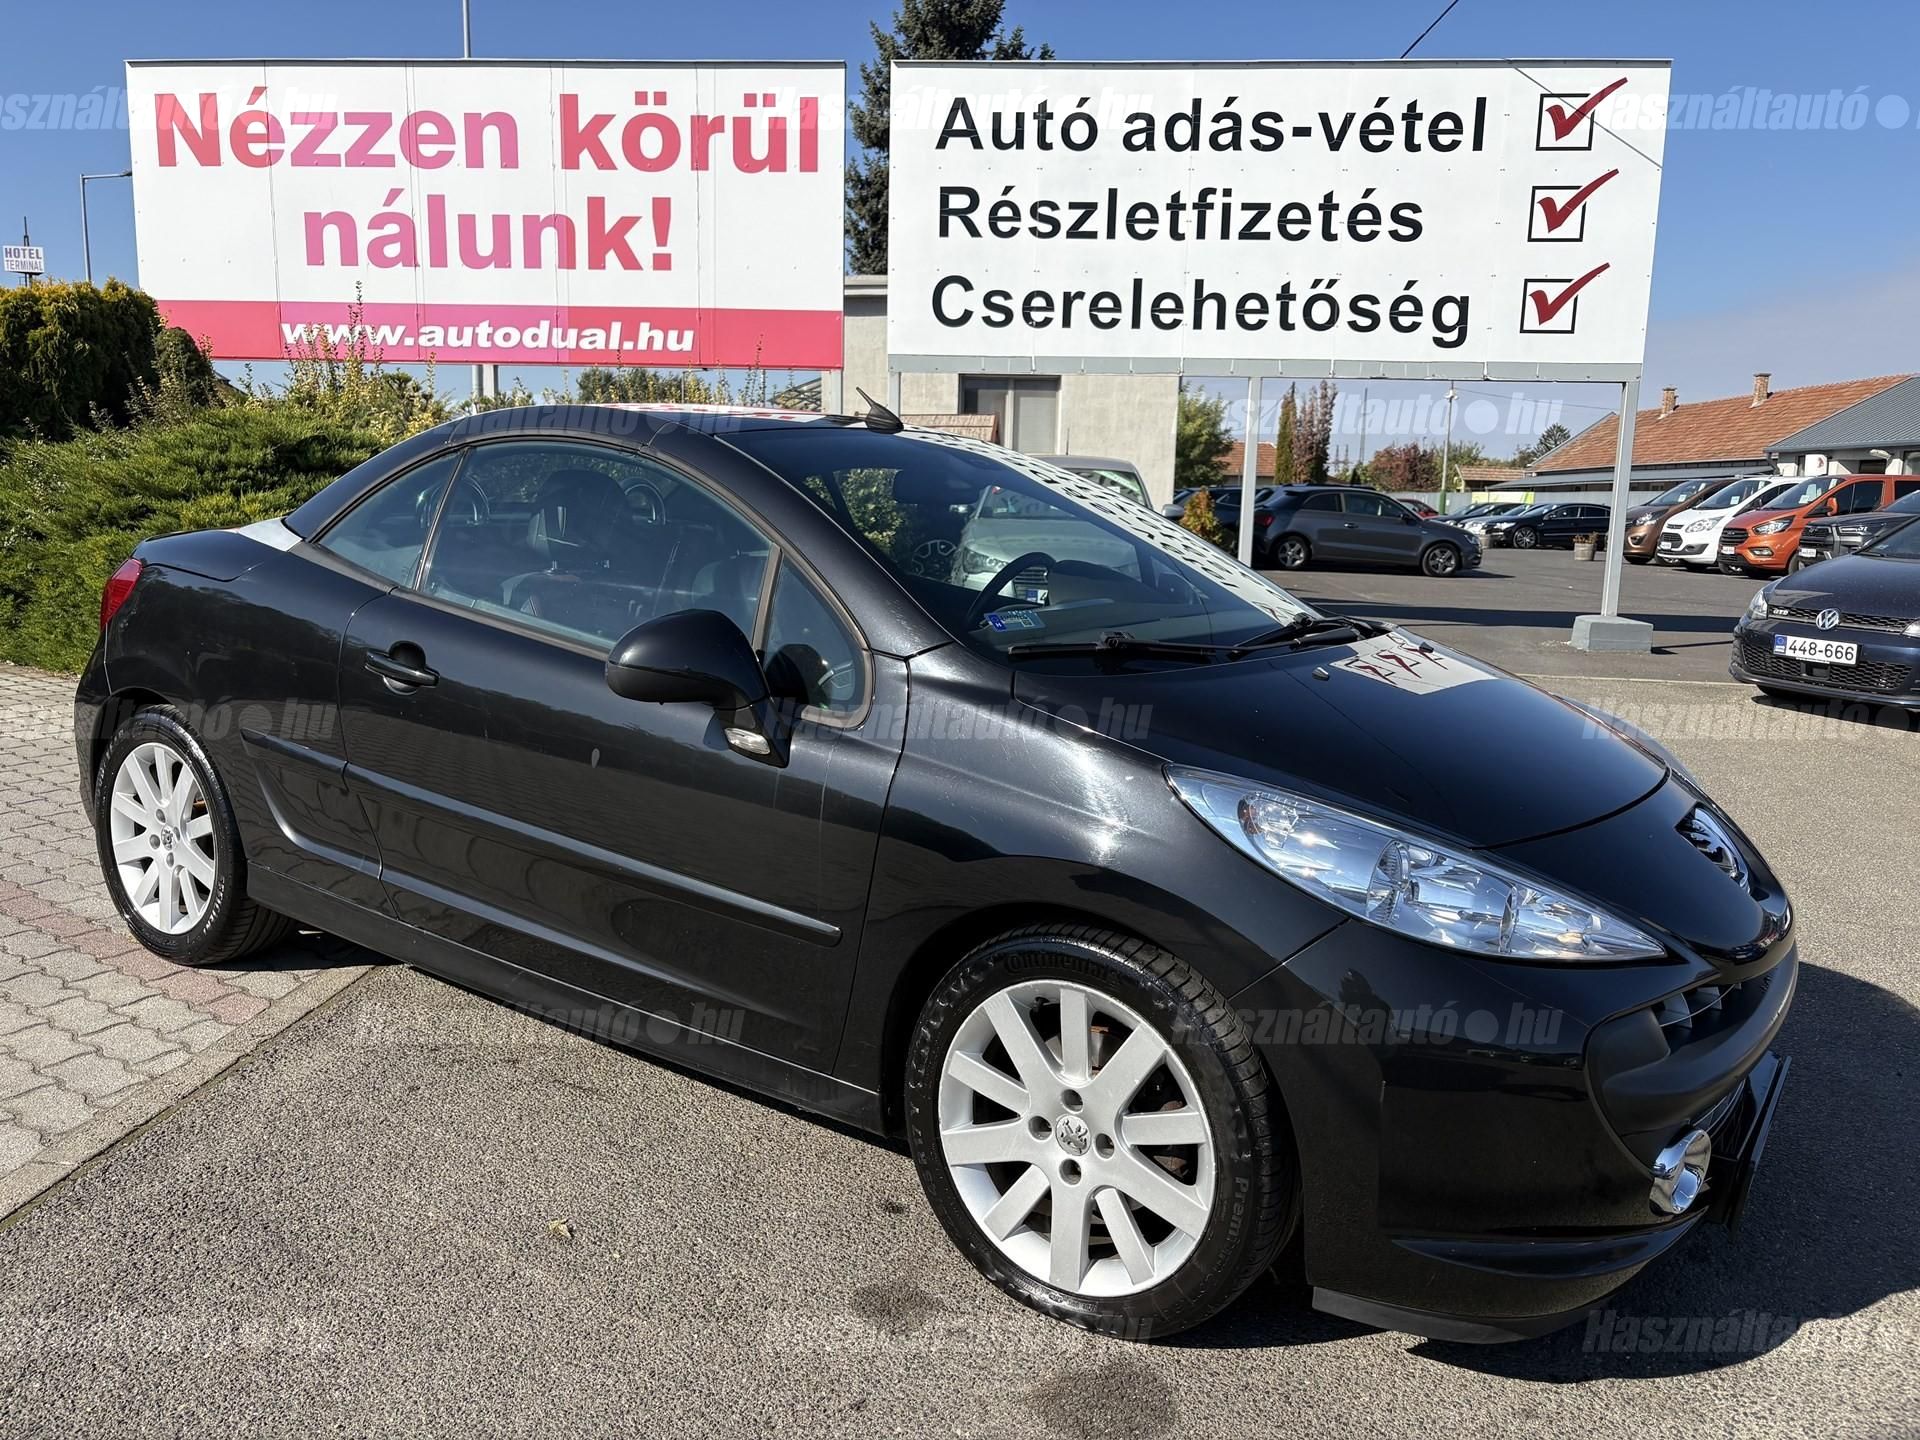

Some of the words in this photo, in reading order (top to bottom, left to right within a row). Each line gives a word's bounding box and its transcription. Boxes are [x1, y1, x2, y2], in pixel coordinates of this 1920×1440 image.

[154, 86, 519, 169] Nézzen
[559, 90, 819, 174] körül
[935, 92, 1098, 153] Autó
[1122, 92, 1487, 154] adás-vétel
[303, 187, 672, 272] nálunk!
[936, 185, 1424, 244] Részletfizetés
[5, 248, 42, 259] HOTEL
[281, 320, 694, 353] www.autodual.hu
[930, 275, 1471, 348] Cserelehetőség
[1789, 640, 1854, 660] 448-666
